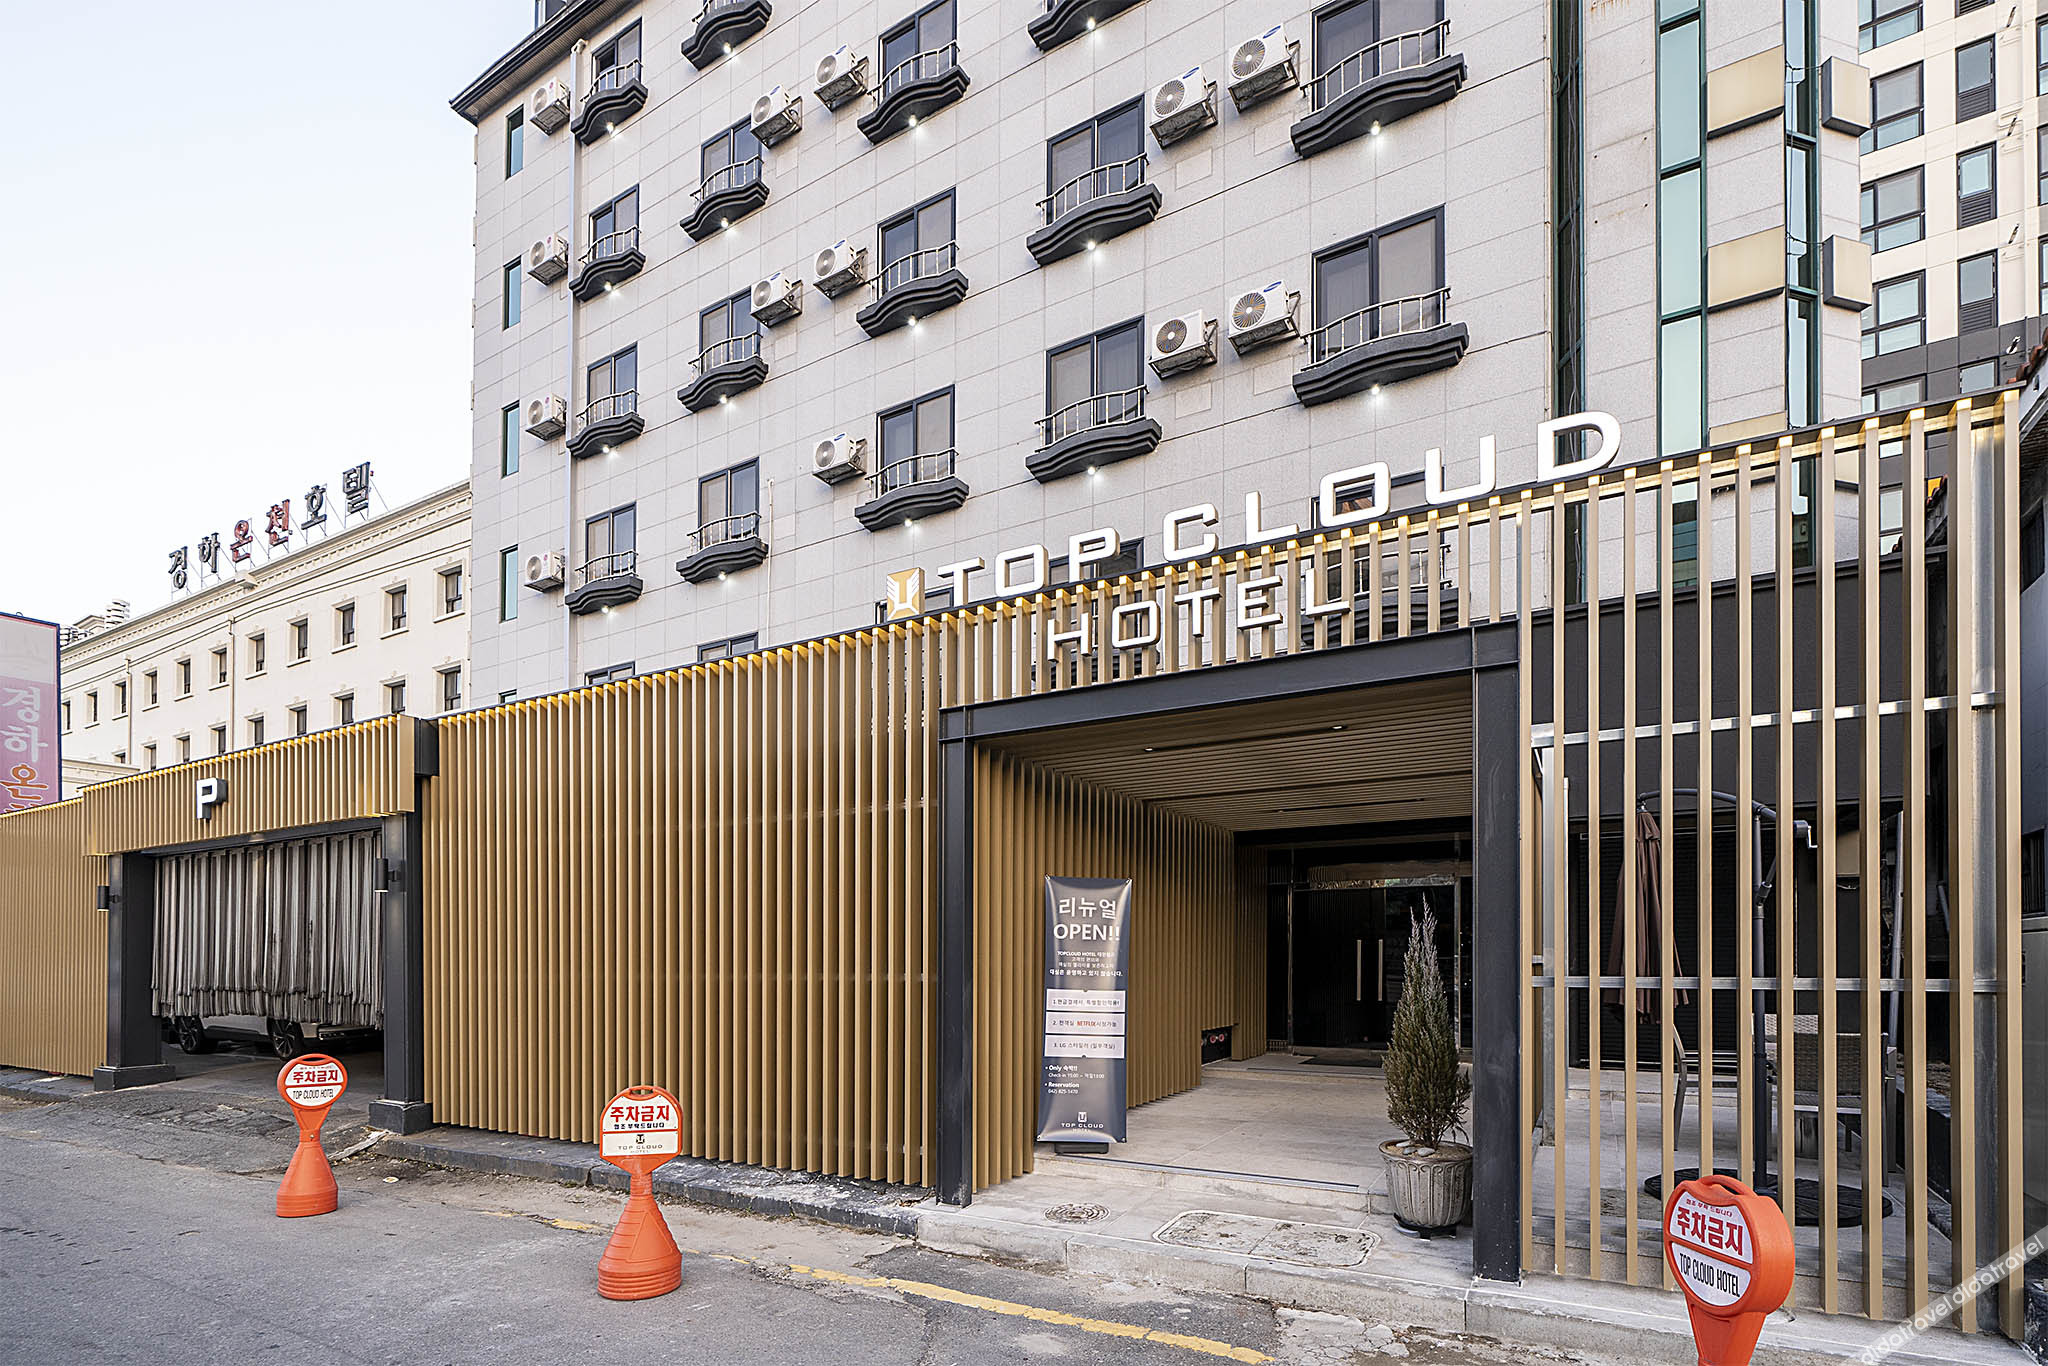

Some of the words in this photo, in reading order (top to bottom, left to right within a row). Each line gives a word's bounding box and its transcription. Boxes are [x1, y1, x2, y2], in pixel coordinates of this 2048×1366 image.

[937, 526, 1119, 599] TOP
[1163, 412, 1622, 560] CLOUD
[1047, 570, 1352, 661] HOTEL
[196, 777, 219, 819] P
[1058, 896, 1116, 920] 리뉴얼
[1053, 923, 1120, 941] OPEN!!
[293, 1069, 339, 1084] 주차금지
[1048, 1065, 1062, 1073] Only
[293, 1090, 303, 1099] TOP
[304, 1089, 319, 1099] CLOUD
[320, 1088, 334, 1098] HOTEL
[610, 1104, 670, 1123] 주차금지
[1677, 1206, 1743, 1256] 주차금지
[1680, 1253, 1691, 1277] TOP
[1692, 1259, 1715, 1288] CLOUD
[1716, 1268, 1740, 1298] HOTEL
